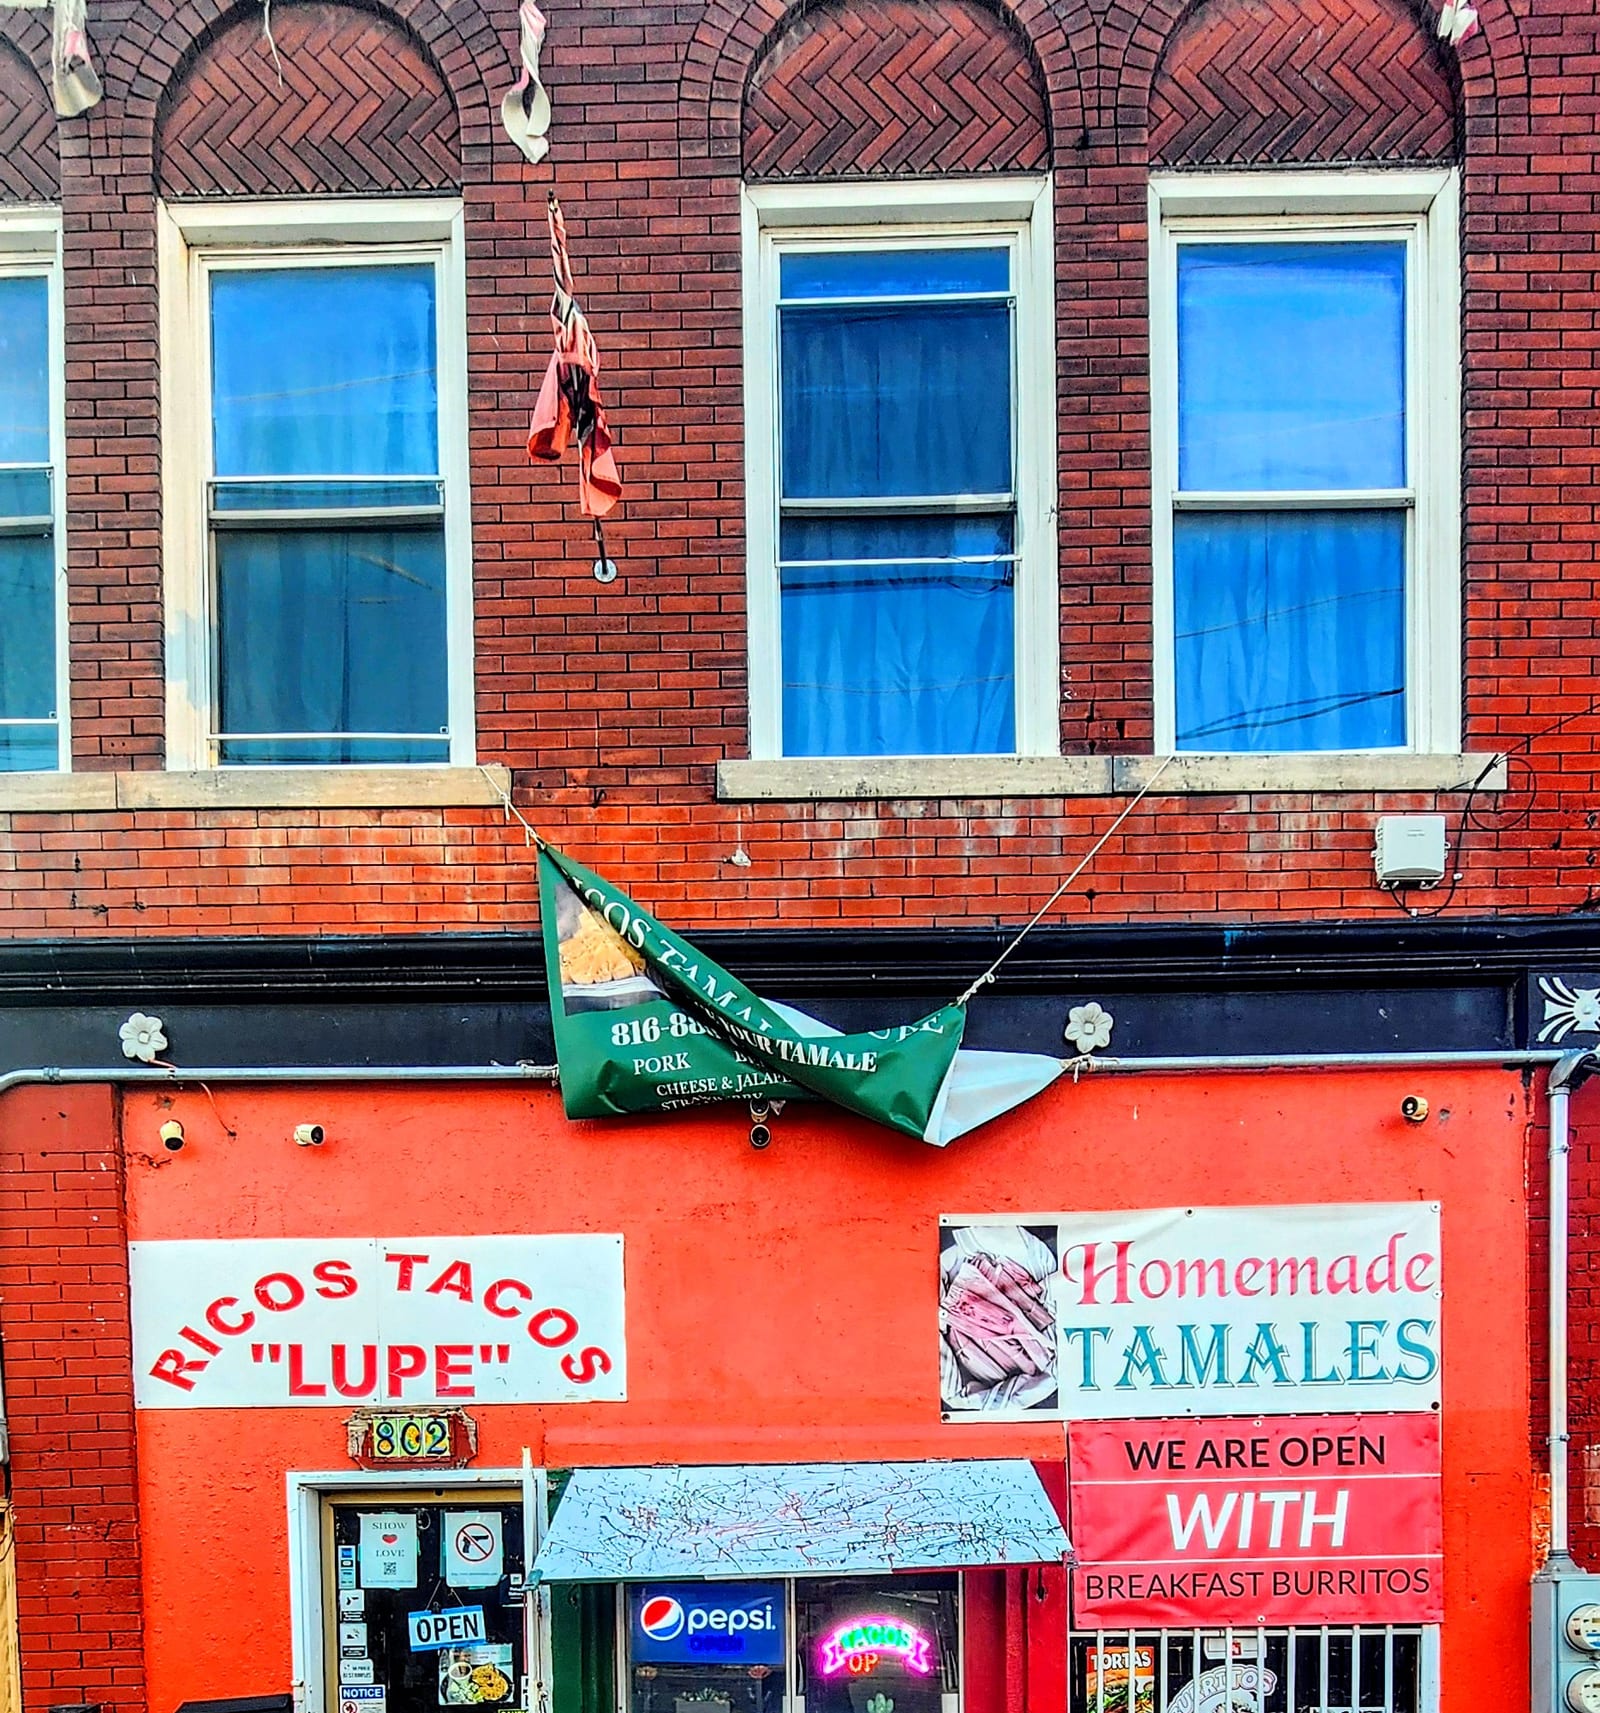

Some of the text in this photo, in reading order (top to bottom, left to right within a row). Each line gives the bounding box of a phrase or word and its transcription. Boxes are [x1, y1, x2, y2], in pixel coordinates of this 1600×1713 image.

[633, 1052, 691, 1075] PORK
[776, 1039, 878, 1073] TAMALE
[656, 1078, 717, 1096] CHEESE
[721, 1076, 733, 1090] &
[1062, 1232, 1437, 1306] Homemade
[148, 1253, 613, 1392] RICOS TACOS
[250, 1343, 511, 1398] "LUPE"
[1063, 1317, 1439, 1392] TAMALES
[375, 1421, 450, 1456] 802
[1124, 1436, 1386, 1471] WE ARE OPEN
[372, 1522, 407, 1530] SHOW
[1165, 1489, 1349, 1551] WITH
[376, 1549, 405, 1557] LOVE
[1086, 1567, 1431, 1600] BREAKFAST BURRITOS
[416, 1613, 479, 1643] OPEN
[687, 1605, 774, 1636] pepsi
[840, 1624, 912, 1650] TACOS
[1091, 1651, 1152, 1671] TORTAS
[343, 1688, 382, 1698] NOTICE
